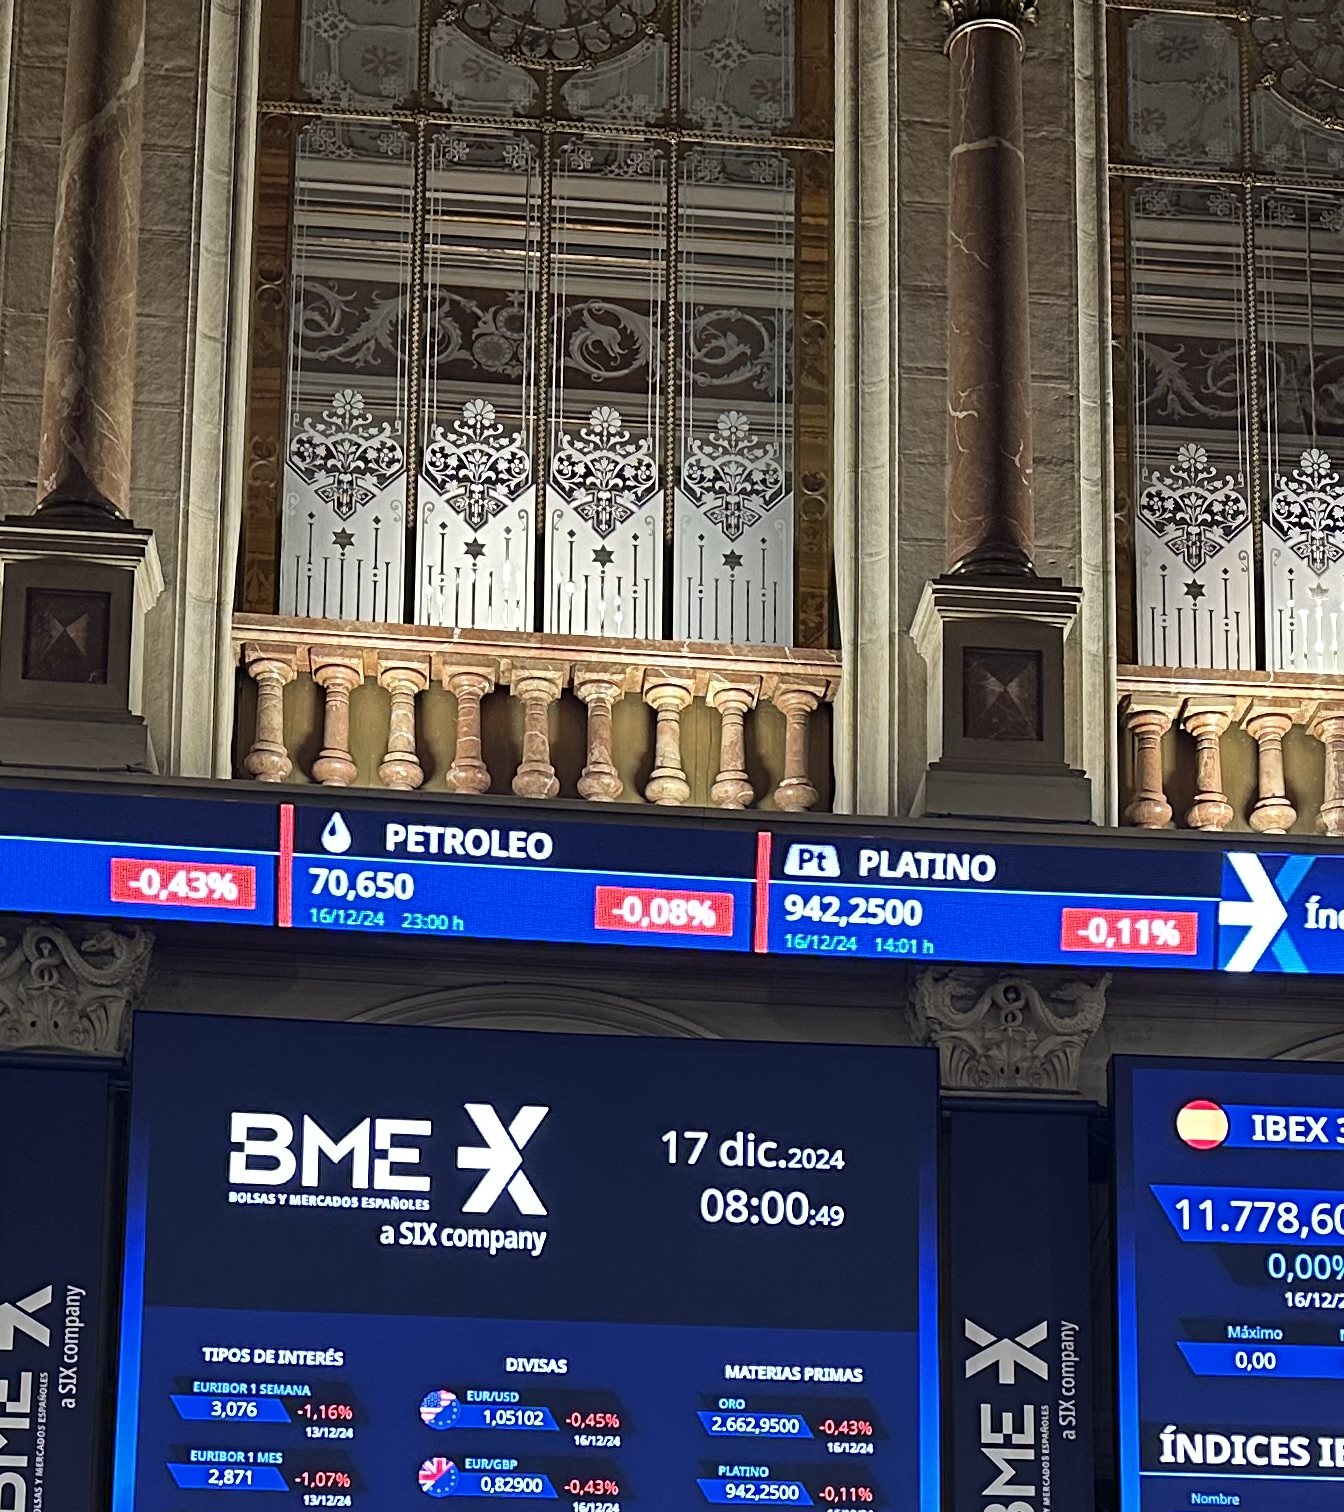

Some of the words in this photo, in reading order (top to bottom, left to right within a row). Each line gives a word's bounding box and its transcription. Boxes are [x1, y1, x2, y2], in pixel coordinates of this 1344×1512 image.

[386, 824, 552, 860] PETROLEO
[799, 848, 826, 871] Pt
[859, 850, 996, 882] PLATINO
[124, 868, 238, 902] -0,43%
[308, 868, 414, 901] 70,650
[612, 896, 716, 928] -0,08%
[784, 894, 922, 927] 942,2500
[1078, 917, 1180, 948] -0,11%
[1252, 1115, 1329, 1142] IBEX
[228, 1110, 433, 1193] BME
[662, 1131, 708, 1164] 17
[229, 1192, 276, 1204] BOLSAS
[278, 1194, 287, 1205] Y
[289, 1195, 358, 1208] MERCADOS
[361, 1196, 429, 1210] ESPAÑOLES
[380, 1226, 394, 1244] a
[399, 1222, 437, 1246] SIX
[441, 1228, 547, 1256] company
[1228, 1325, 1283, 1339] Máximo
[202, 1347, 250, 1362] TIPOS
[254, 1349, 275, 1363] DE
[278, 1348, 343, 1366] INTERÉS
[506, 1358, 567, 1373] DIVISAS
[1061, 1321, 1079, 1395] company
[1236, 1352, 1276, 1371] 0,00
[725, 1365, 801, 1380] MATERIAS
[804, 1367, 863, 1382] PRIMAS
[194, 1381, 247, 1394] EURIBOR
[251, 1384, 256, 1394] 1
[260, 1384, 311, 1396] SEMANA
[467, 1391, 519, 1402] EUR/USD
[211, 1401, 257, 1418] 3,076
[298, 1404, 352, 1420] -1,16%
[719, 1399, 745, 1409] ORO
[1059, 1400, 1075, 1426] SIX
[484, 1410, 544, 1426] 1,05102
[566, 1412, 619, 1428] -0,45%
[712, 1417, 799, 1434] 2.662,9500
[306, 1427, 353, 1438] 13/12/24
[819, 1420, 872, 1435] -0,43%
[1063, 1430, 1076, 1439] a
[574, 1435, 620, 1447] 16/12/24
[1160, 1425, 1310, 1466] ÍNDICES
[1192, 1493, 1239, 1505] Nombre
